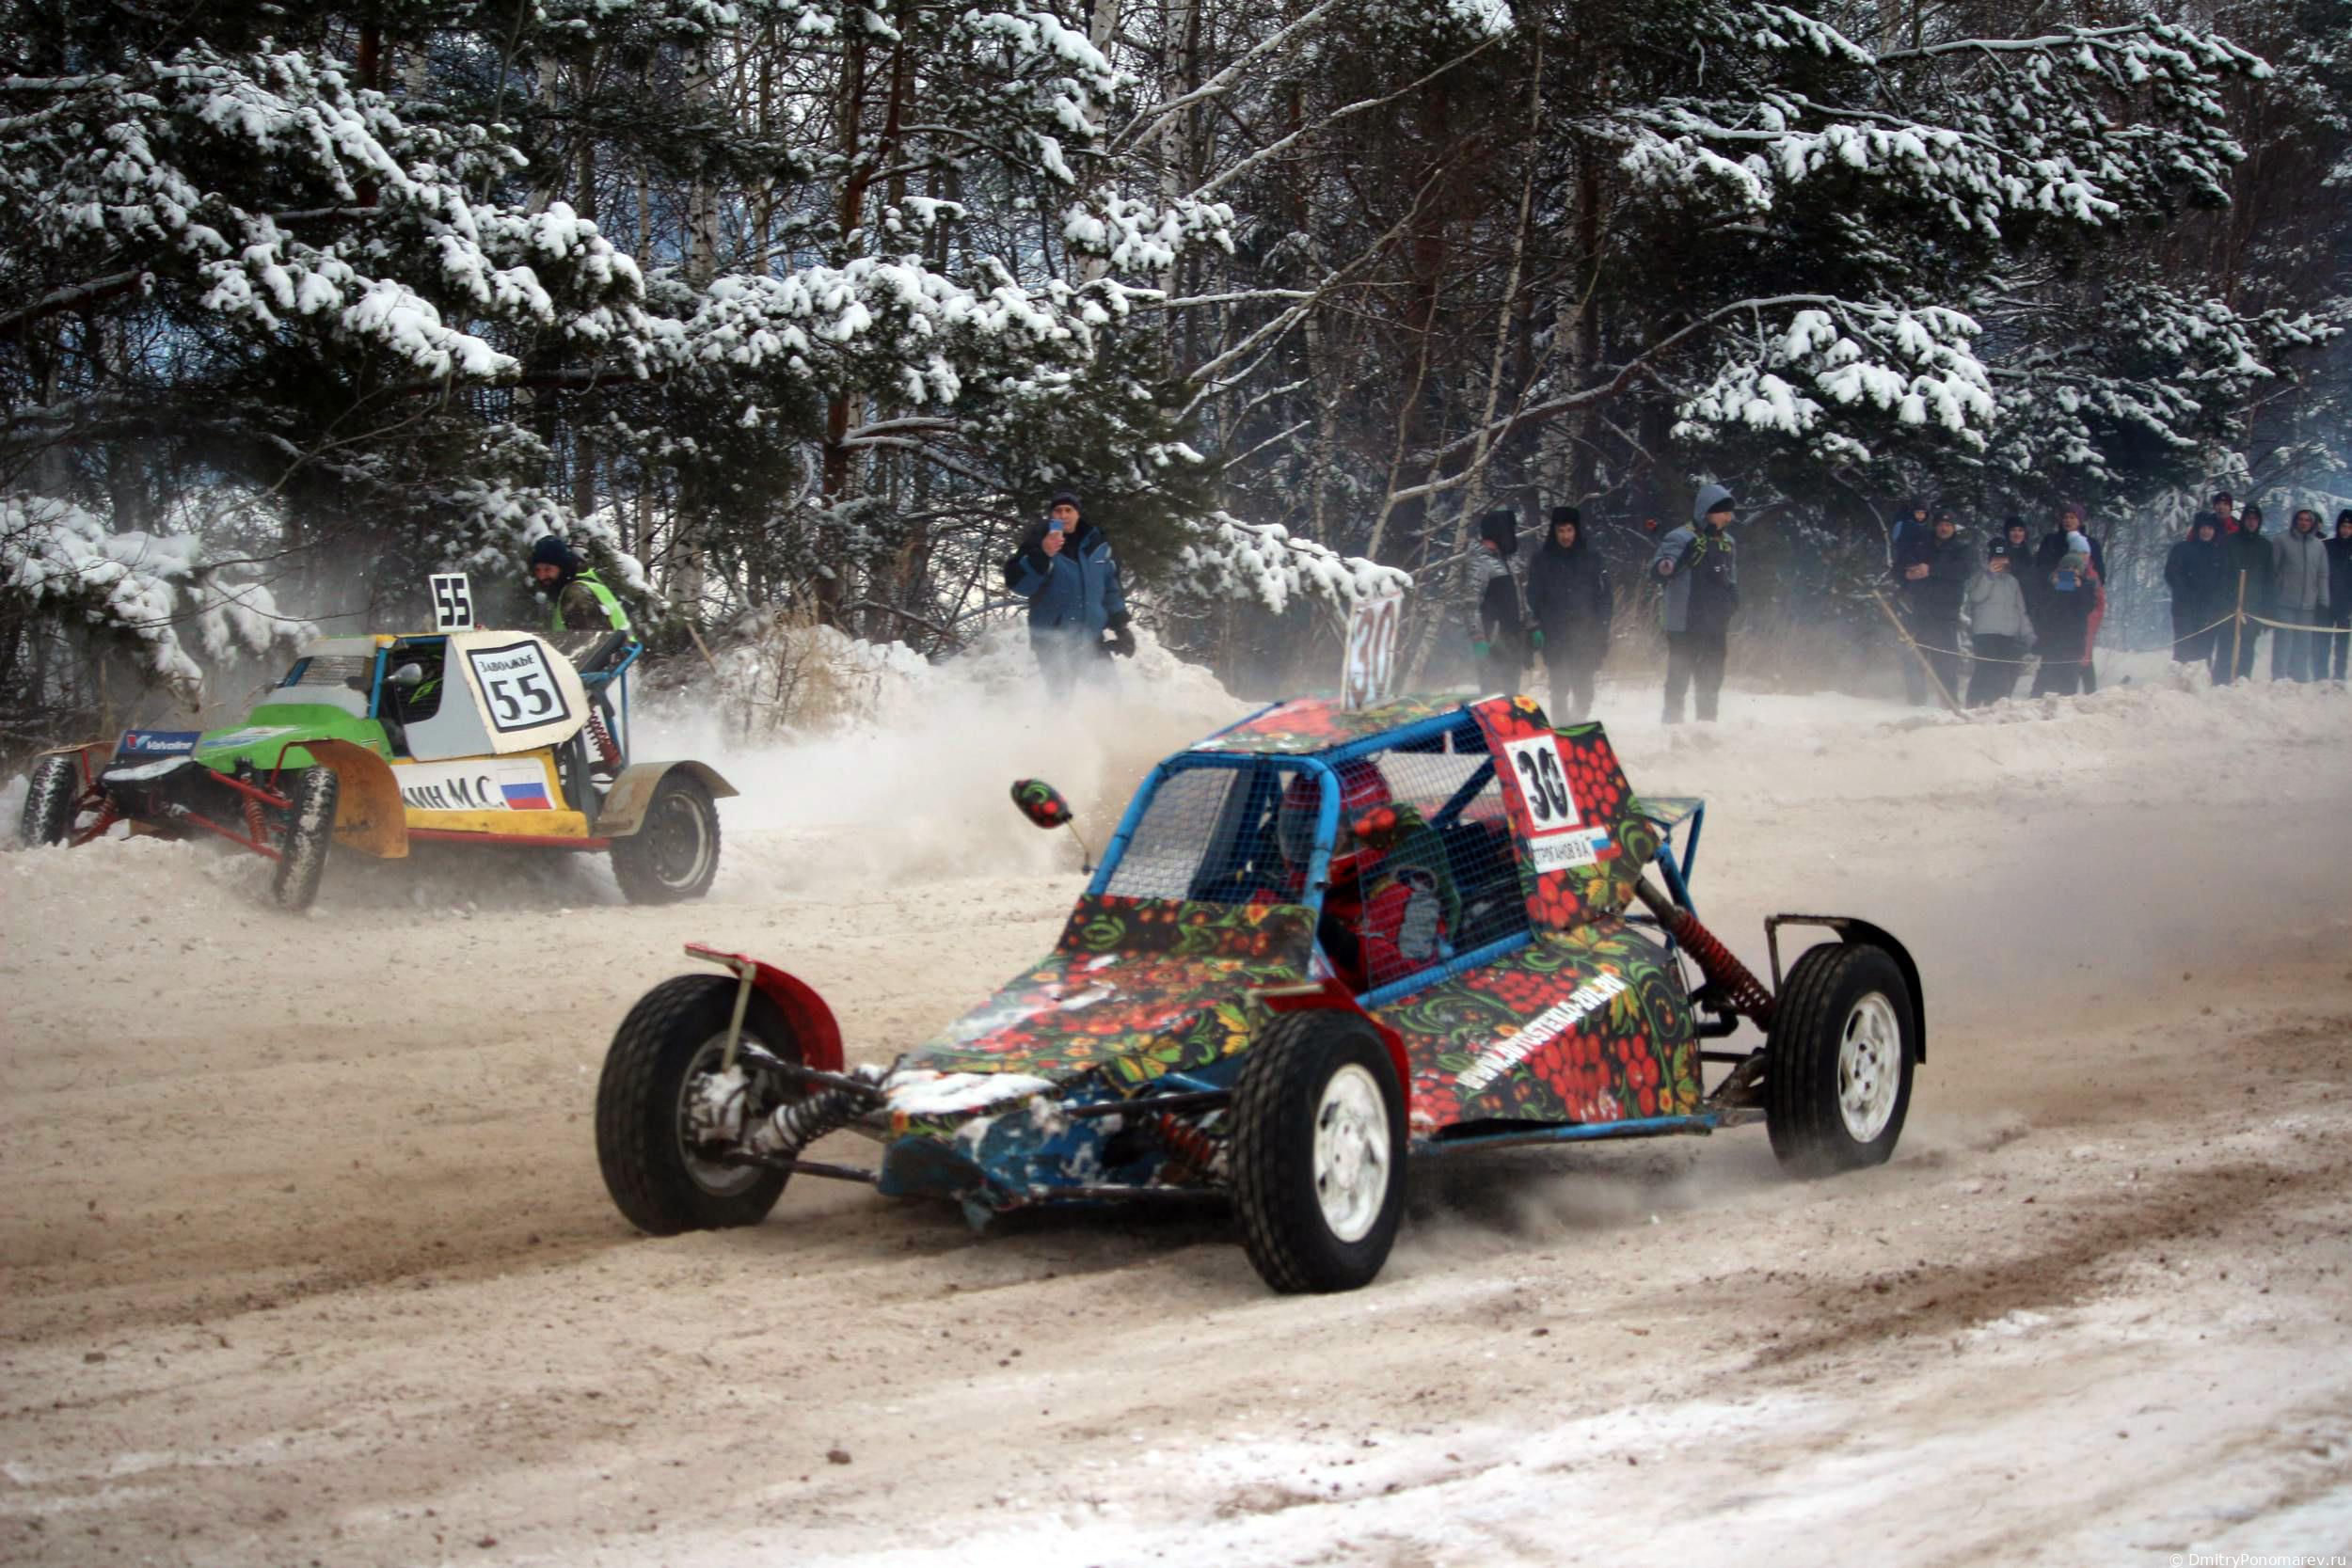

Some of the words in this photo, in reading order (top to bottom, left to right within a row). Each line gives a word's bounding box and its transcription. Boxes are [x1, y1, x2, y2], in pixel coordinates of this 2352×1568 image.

[433, 578, 470, 626] 55
[489, 673, 553, 721] 55
[1517, 747, 1569, 822] 30
